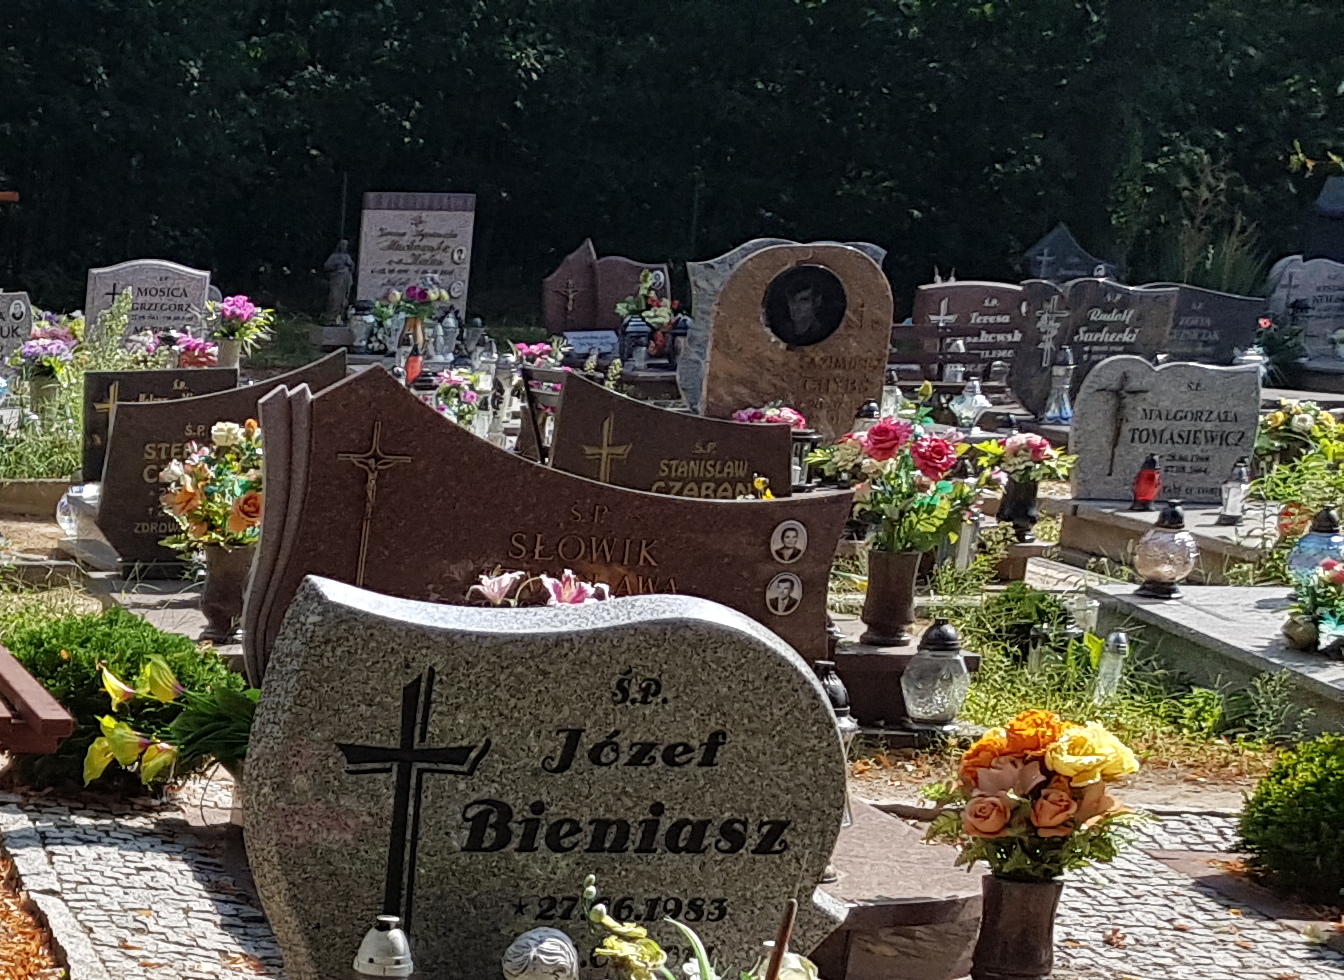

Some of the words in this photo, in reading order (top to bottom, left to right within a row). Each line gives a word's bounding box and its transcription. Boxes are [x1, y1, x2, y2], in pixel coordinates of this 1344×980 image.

[1128, 427, 1246, 447] TOMASIEWICZ
[658, 459, 748, 478] STANISŁAW
[133, 522, 180, 534] ZDROW
[507, 532, 660, 568] SŁOWIK
[613, 666, 669, 705] Ś.P.
[541, 728, 728, 774] Józef
[462, 800, 793, 855] Bieniasz
